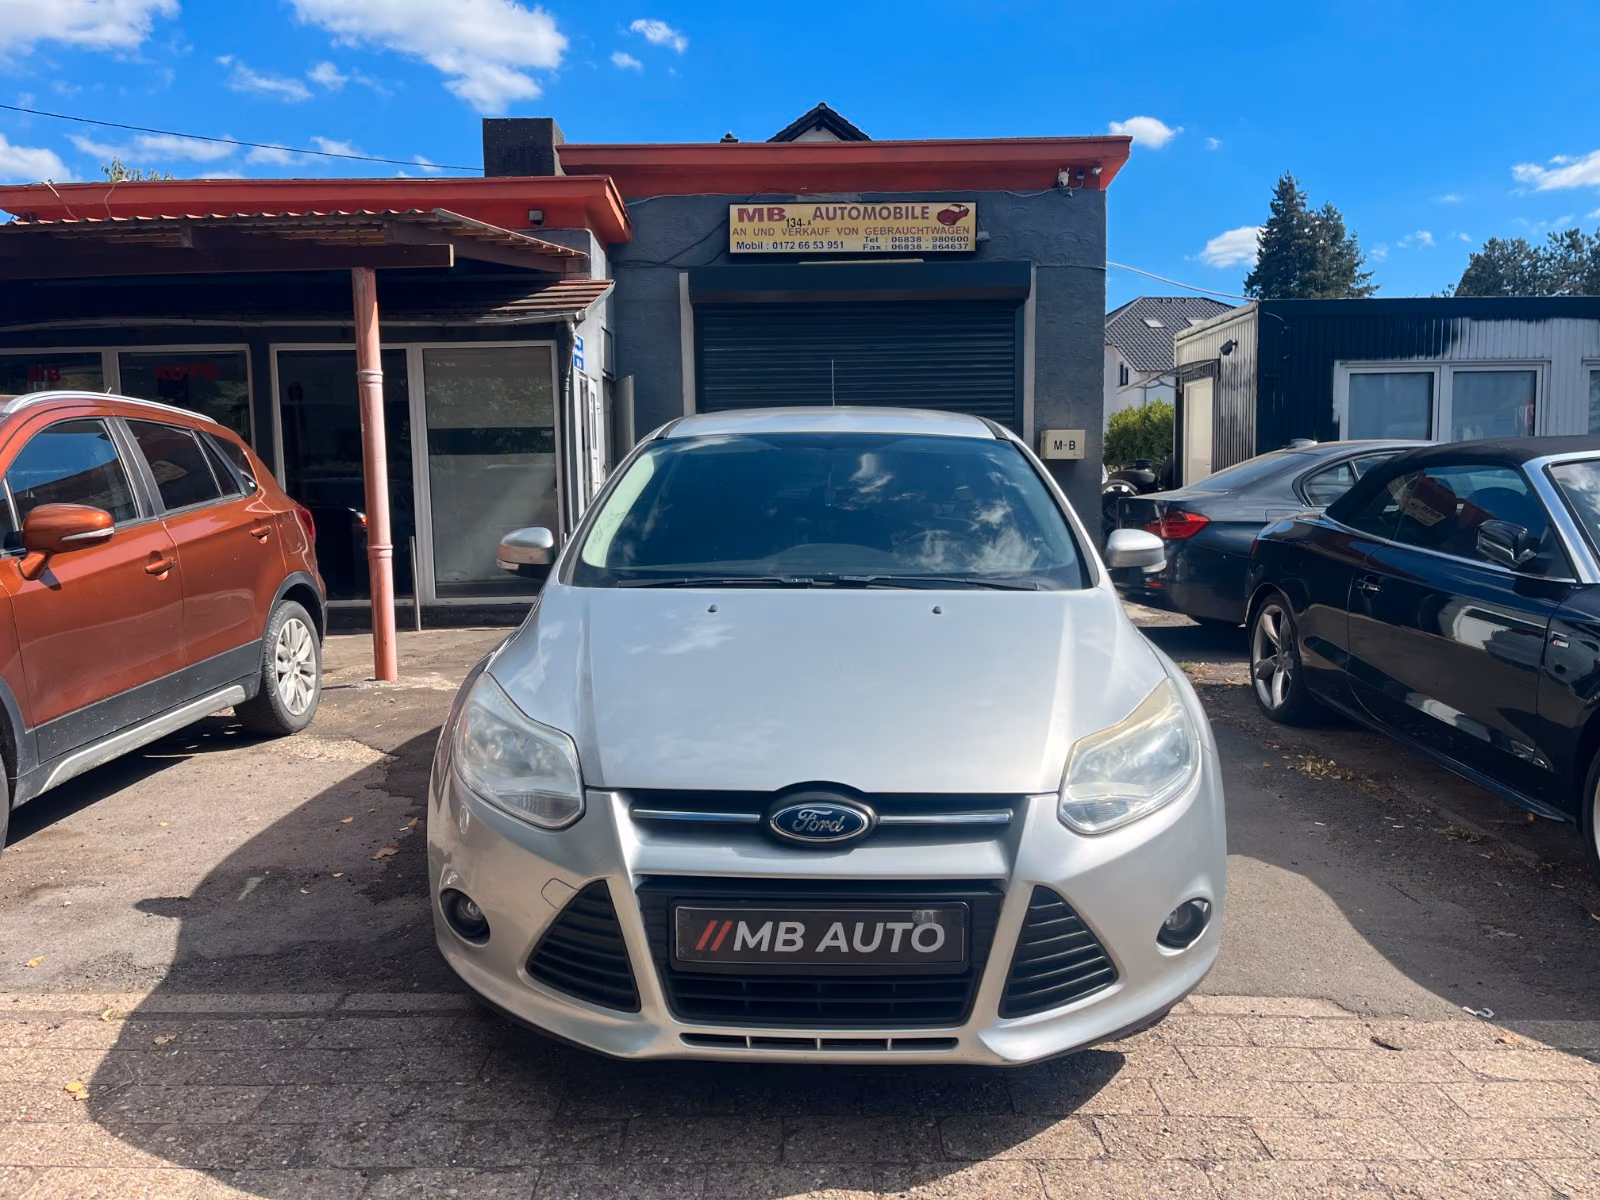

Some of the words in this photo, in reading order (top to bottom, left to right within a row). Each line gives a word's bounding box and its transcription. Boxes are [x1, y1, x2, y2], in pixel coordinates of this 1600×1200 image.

[738, 207, 787, 222] MB
[812, 206, 930, 221] AUTOMOBILE
[732, 228, 747, 236] AN
[753, 228, 775, 237] UND
[781, 227, 831, 236] VERKAUF
[837, 227, 859, 236] VON
[865, 226, 970, 236] GEBRAUCHTWAGEN
[736, 241, 763, 250] Mobil
[772, 241, 795, 250] 0172
[798, 241, 810, 250] 66
[813, 241, 824, 250] 53
[827, 241, 844, 249] 951
[1053, 440, 1076, 451] M-B
[792, 809, 845, 832] Ford
[815, 922, 945, 953] AUTO
